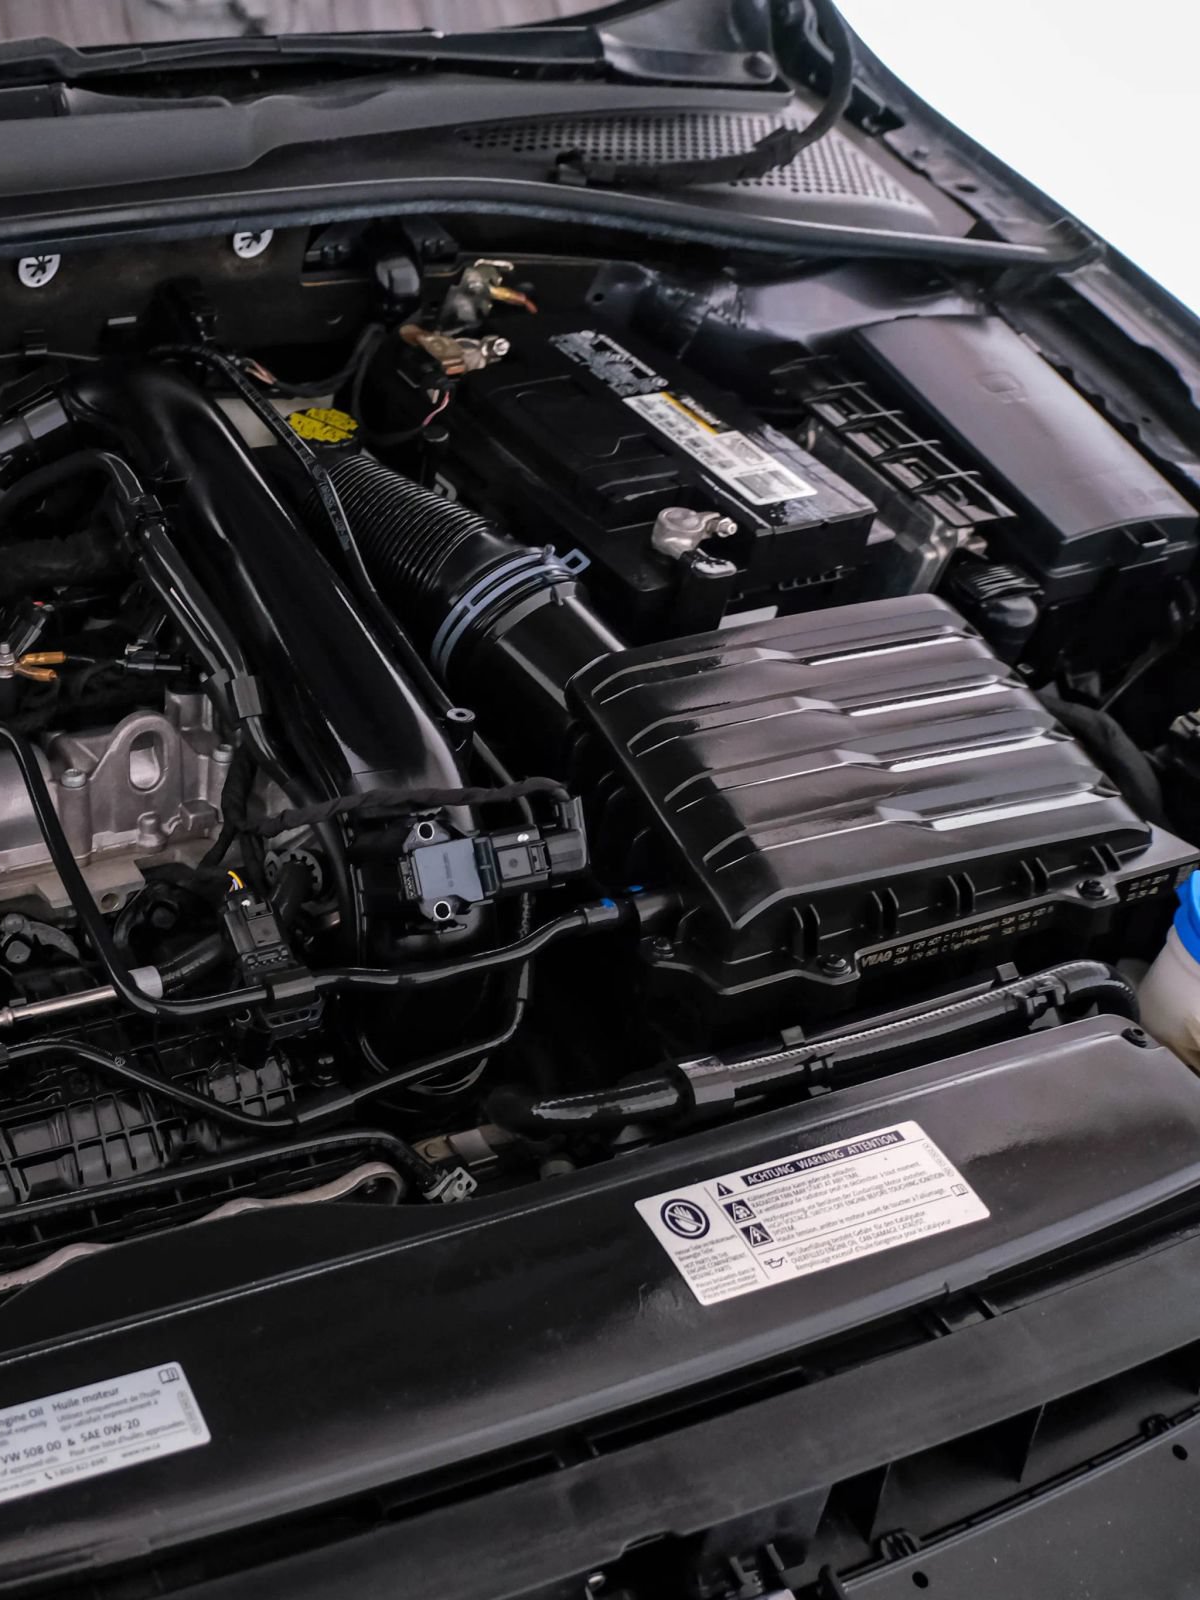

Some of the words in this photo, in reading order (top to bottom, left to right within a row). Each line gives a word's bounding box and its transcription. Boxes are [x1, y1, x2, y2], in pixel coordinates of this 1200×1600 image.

[744, 1163, 796, 1184] ACHTUNG
[795, 1149, 845, 1169] WARNING
[845, 1133, 898, 1154] ATTENTION
[883, 1178, 902, 1186] Motor
[750, 1196, 780, 1207] RADIATOR
[806, 1183, 823, 1191] START
[766, 1221, 783, 1229] HIGH
[808, 1206, 833, 1216] SWITCH
[843, 1195, 866, 1205] ENGINE
[865, 1189, 888, 1199] BEFORE
[887, 1180, 918, 1192] TOUCHING
[917, 1172, 944, 1183] IGNITION
[865, 1207, 883, 1215] avant
[830, 1232, 853, 1243] besteht
[852, 1226, 873, 1236] Gefahr
[790, 1249, 825, 1263] OVERFILLED
[824, 1242, 847, 1253] ENGINE
[858, 1234, 872, 1242] CAN
[871, 1227, 897, 1238] DAMAGE
[830, 1248, 855, 1259] excessif
[686, 1265, 706, 1274] ENGINE
[694, 1257, 711, 1265] PARTS
[27, 1406, 44, 1418] Oil
[51, 1397, 80, 1411] Huile
[80, 1386, 119, 1403] moteur
[0, 1451, 21, 1464] VW
[22, 1444, 44, 1458] 508
[45, 1439, 62, 1451] 00
[79, 1429, 101, 1442] SAE
[102, 1417, 140, 1436] 0W-20
